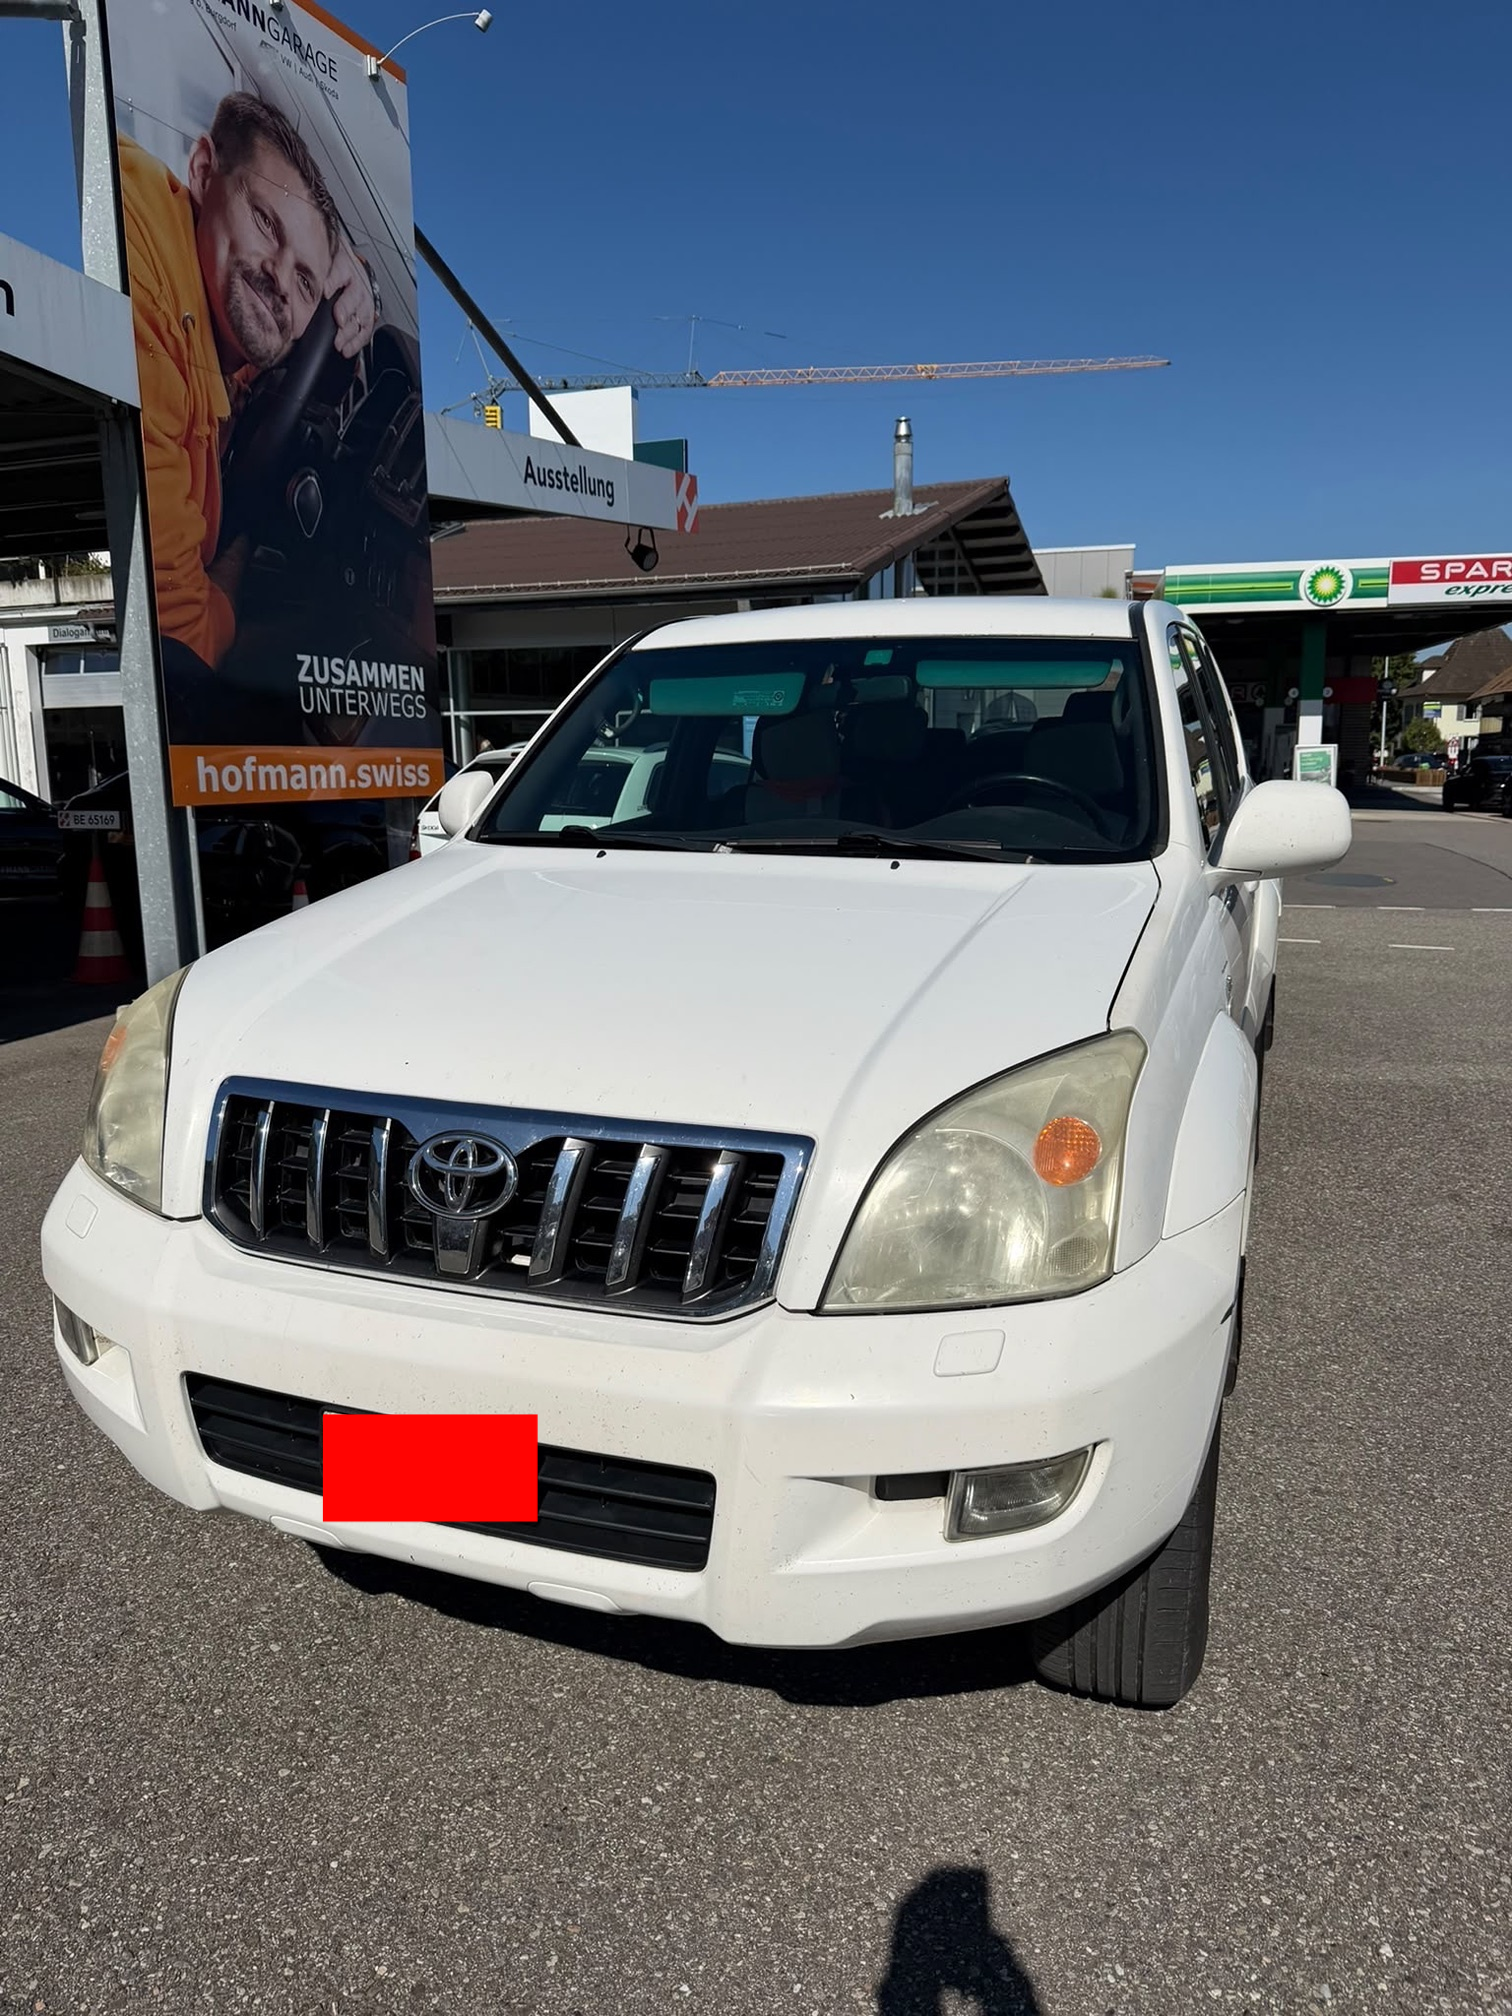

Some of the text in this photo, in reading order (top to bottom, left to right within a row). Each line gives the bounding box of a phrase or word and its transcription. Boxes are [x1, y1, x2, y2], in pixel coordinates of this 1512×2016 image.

[523, 456, 615, 507] Ausstellung
[1420, 560, 1512, 581] SPAR
[1445, 582, 1512, 598] expre
[296, 654, 426, 693] ZUSAMMEN
[299, 686, 427, 719] UNTERWEGS
[196, 755, 431, 793] hofmann.swiss
[73, 814, 115, 825] BE 65169
